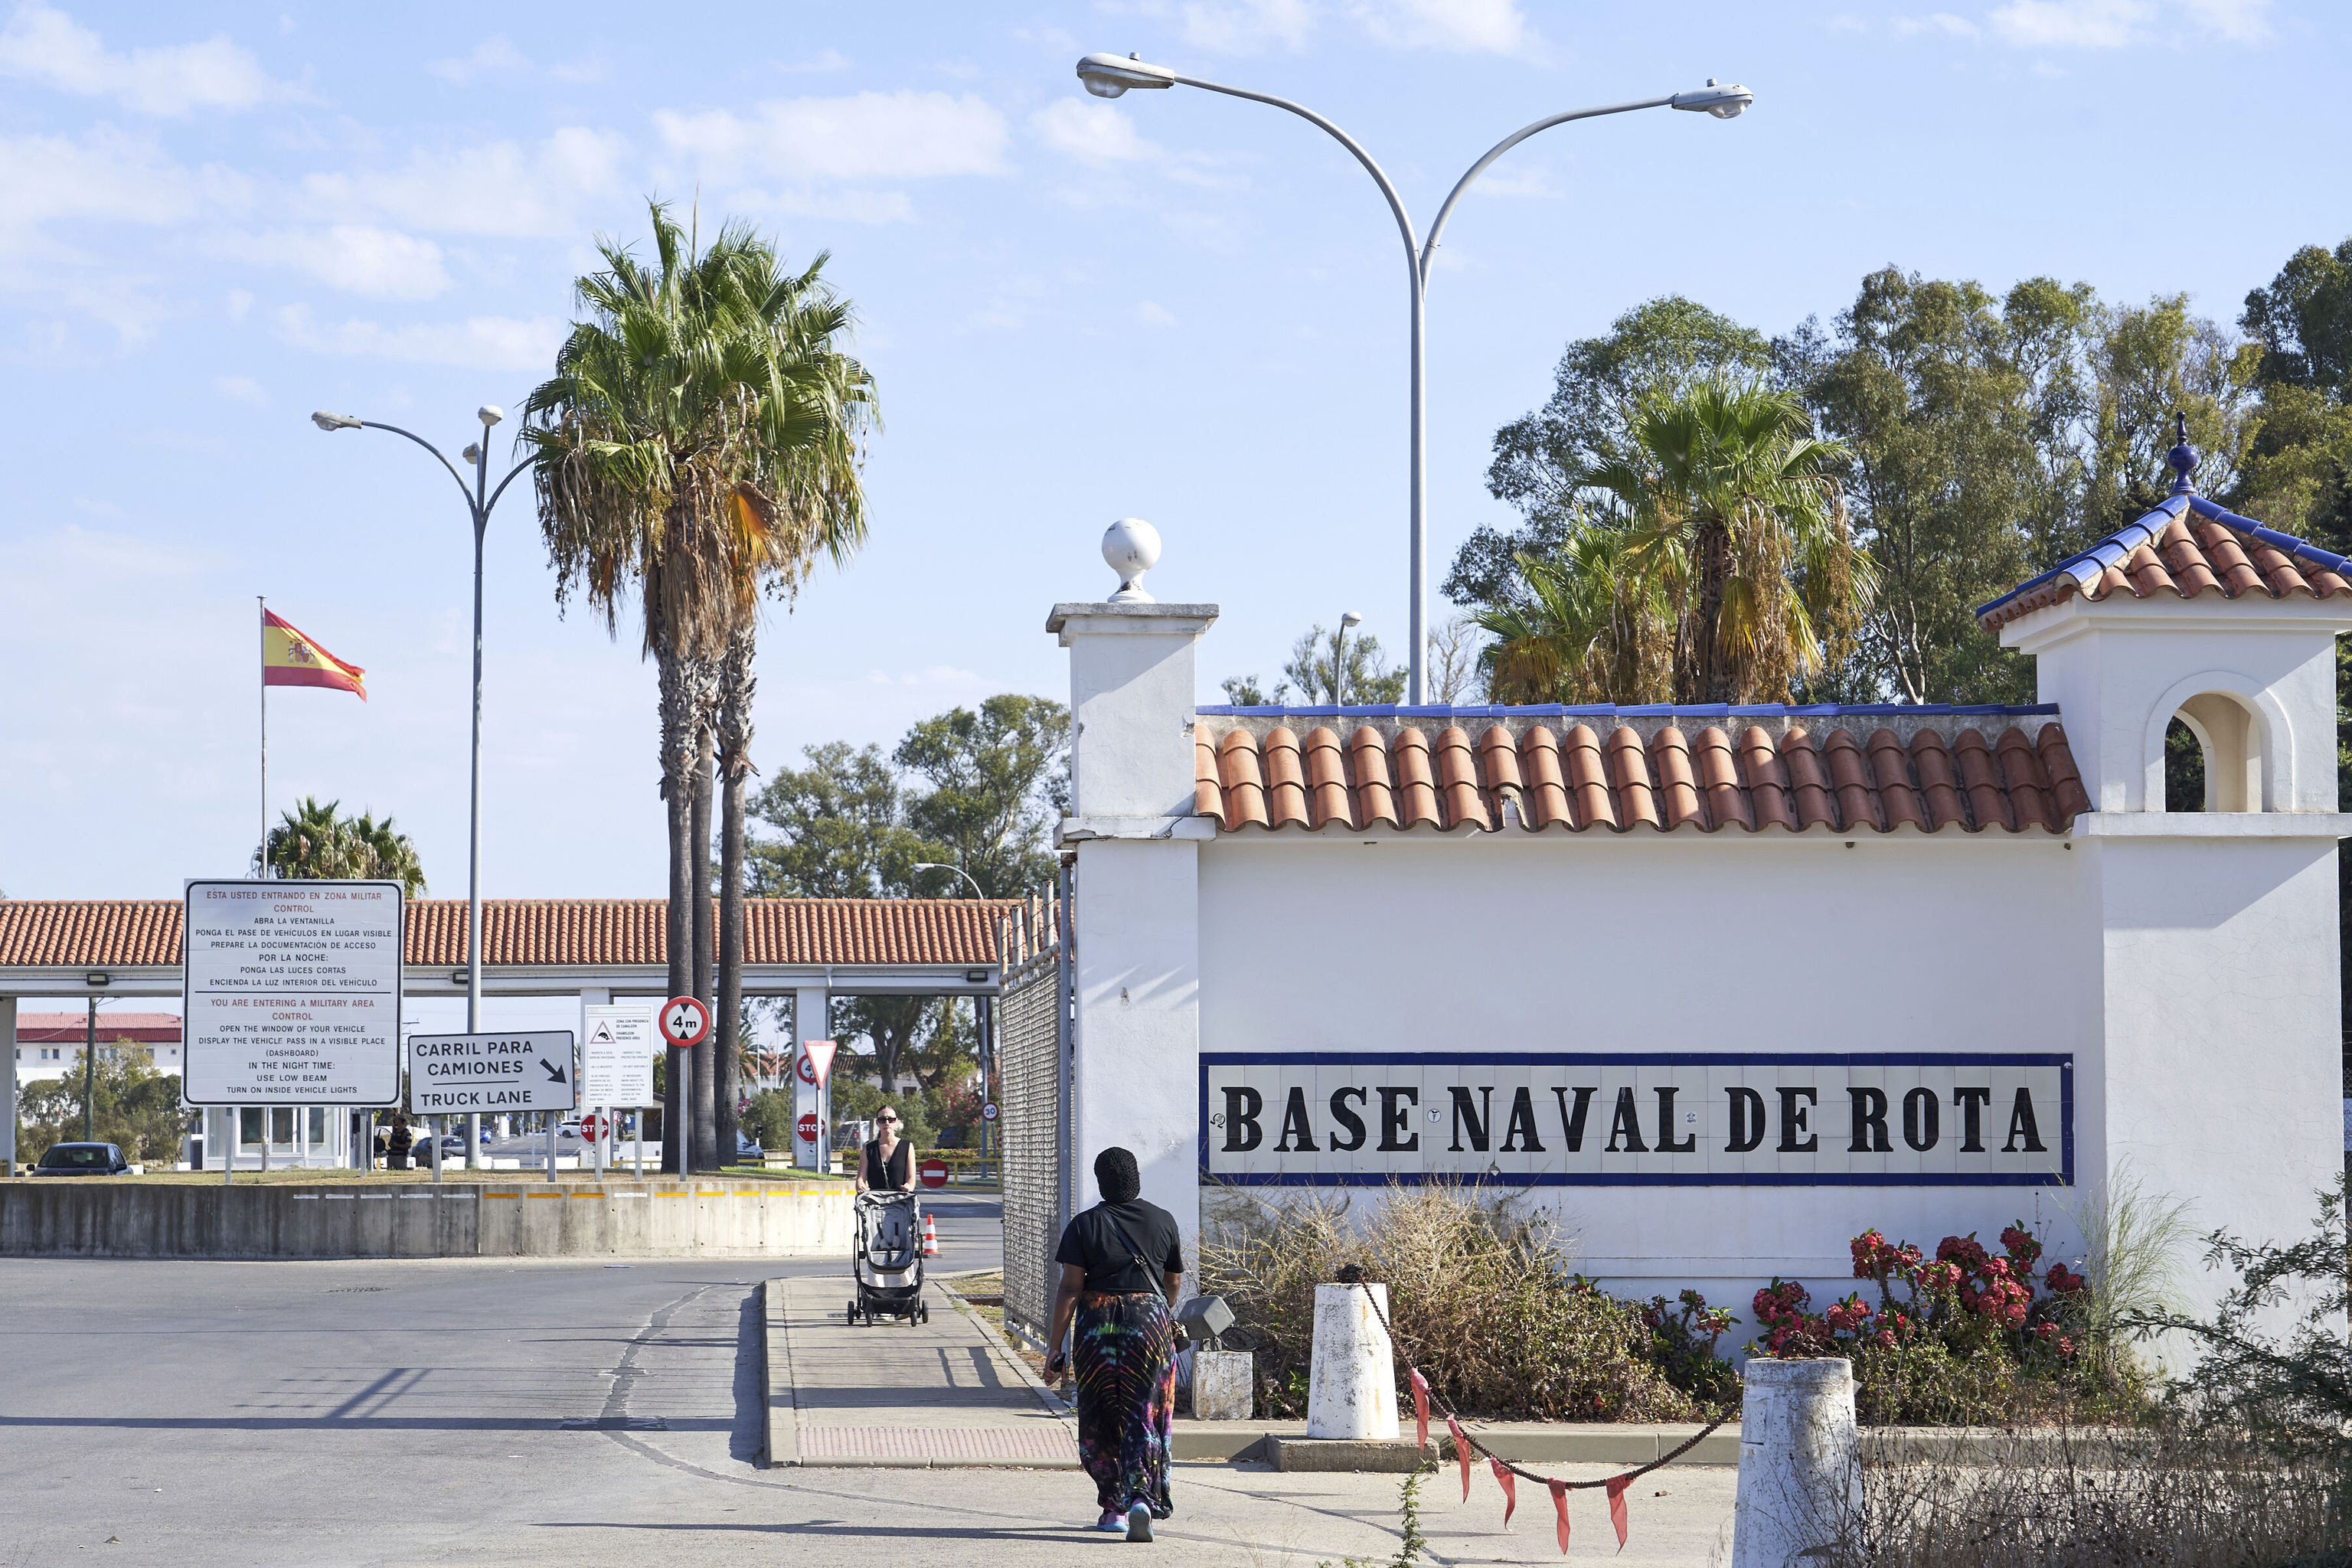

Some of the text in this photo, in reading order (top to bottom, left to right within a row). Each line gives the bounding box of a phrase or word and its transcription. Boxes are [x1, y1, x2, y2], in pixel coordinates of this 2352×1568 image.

[230, 890, 258, 900] USTED
[261, 891, 306, 900] ENTRANDO
[309, 892, 321, 900] EN
[324, 891, 348, 900] ZONA
[350, 892, 382, 901] MILITAR
[273, 904, 315, 913] CONTROL
[253, 917, 275, 926] ABRA
[260, 929, 271, 937] DE
[362, 929, 392, 938] VISIBLE
[258, 953, 328, 962] POR LA NOCHE:
[287, 966, 313, 975] LUCES
[316, 966, 347, 975] CORTAS
[264, 978, 279, 987] LUZ
[211, 998, 374, 1008] YOU ARE ENTERING A MILITARY AREA
[272, 1011, 313, 1021] CONTROL
[219, 1024, 240, 1033] OPEN
[243, 1024, 259, 1033] THE
[261, 1024, 294, 1033] WINDOW
[309, 1024, 331, 1033] YOUR
[198, 1037, 230, 1045] DISPLAY
[232, 1037, 248, 1045] THE
[250, 1037, 283, 1045] VEHICLE
[286, 1037, 306, 1045] PASS
[328, 1037, 358, 1045] VISIBLE
[416, 1040, 534, 1057] CARRIL PARA
[265, 1048, 319, 1059] (DASHBOARD)
[248, 1061, 336, 1070] IN THE NIGHT TIME:
[427, 1060, 524, 1076] CAMIONES
[226, 1086, 247, 1094] TURN
[250, 1086, 263, 1094] ON
[265, 1086, 292, 1094] INSIDE
[330, 1086, 358, 1094] LIGHTS
[420, 1090, 532, 1106] TRUCK LANE
[985, 1107, 995, 1116] 30
[1221, 1086, 2048, 1153] BASE NAVAL DE ROTA
[582, 1125, 608, 1133] STP
